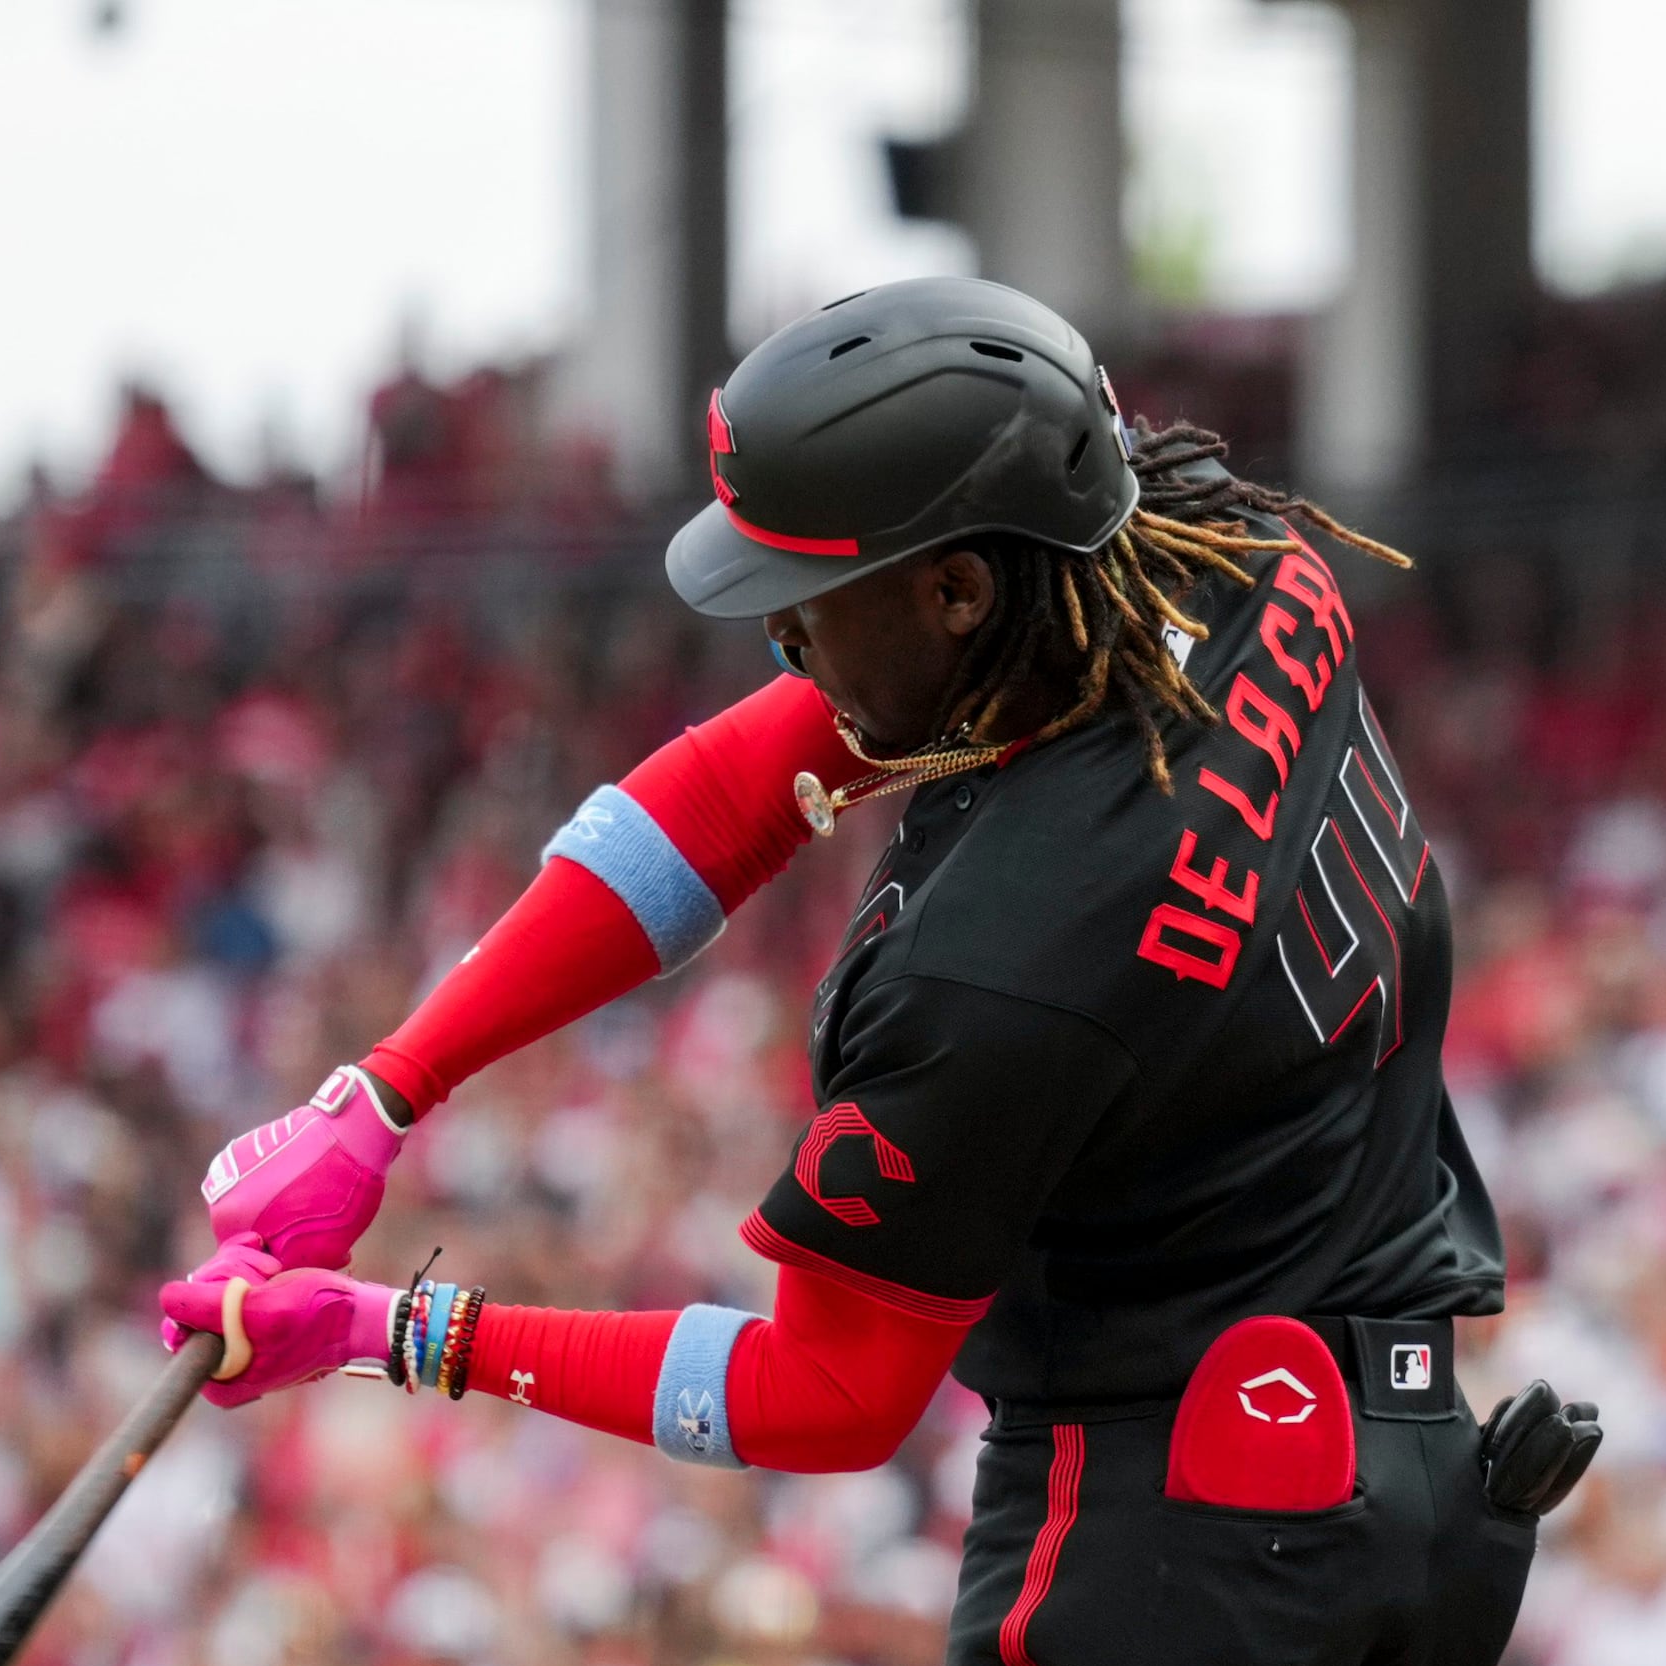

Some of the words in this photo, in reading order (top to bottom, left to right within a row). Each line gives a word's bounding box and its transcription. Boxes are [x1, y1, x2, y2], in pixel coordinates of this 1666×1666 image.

[1136, 828, 1260, 991] DE
[1199, 671, 1302, 841] LA
[794, 1101, 916, 1227] C
